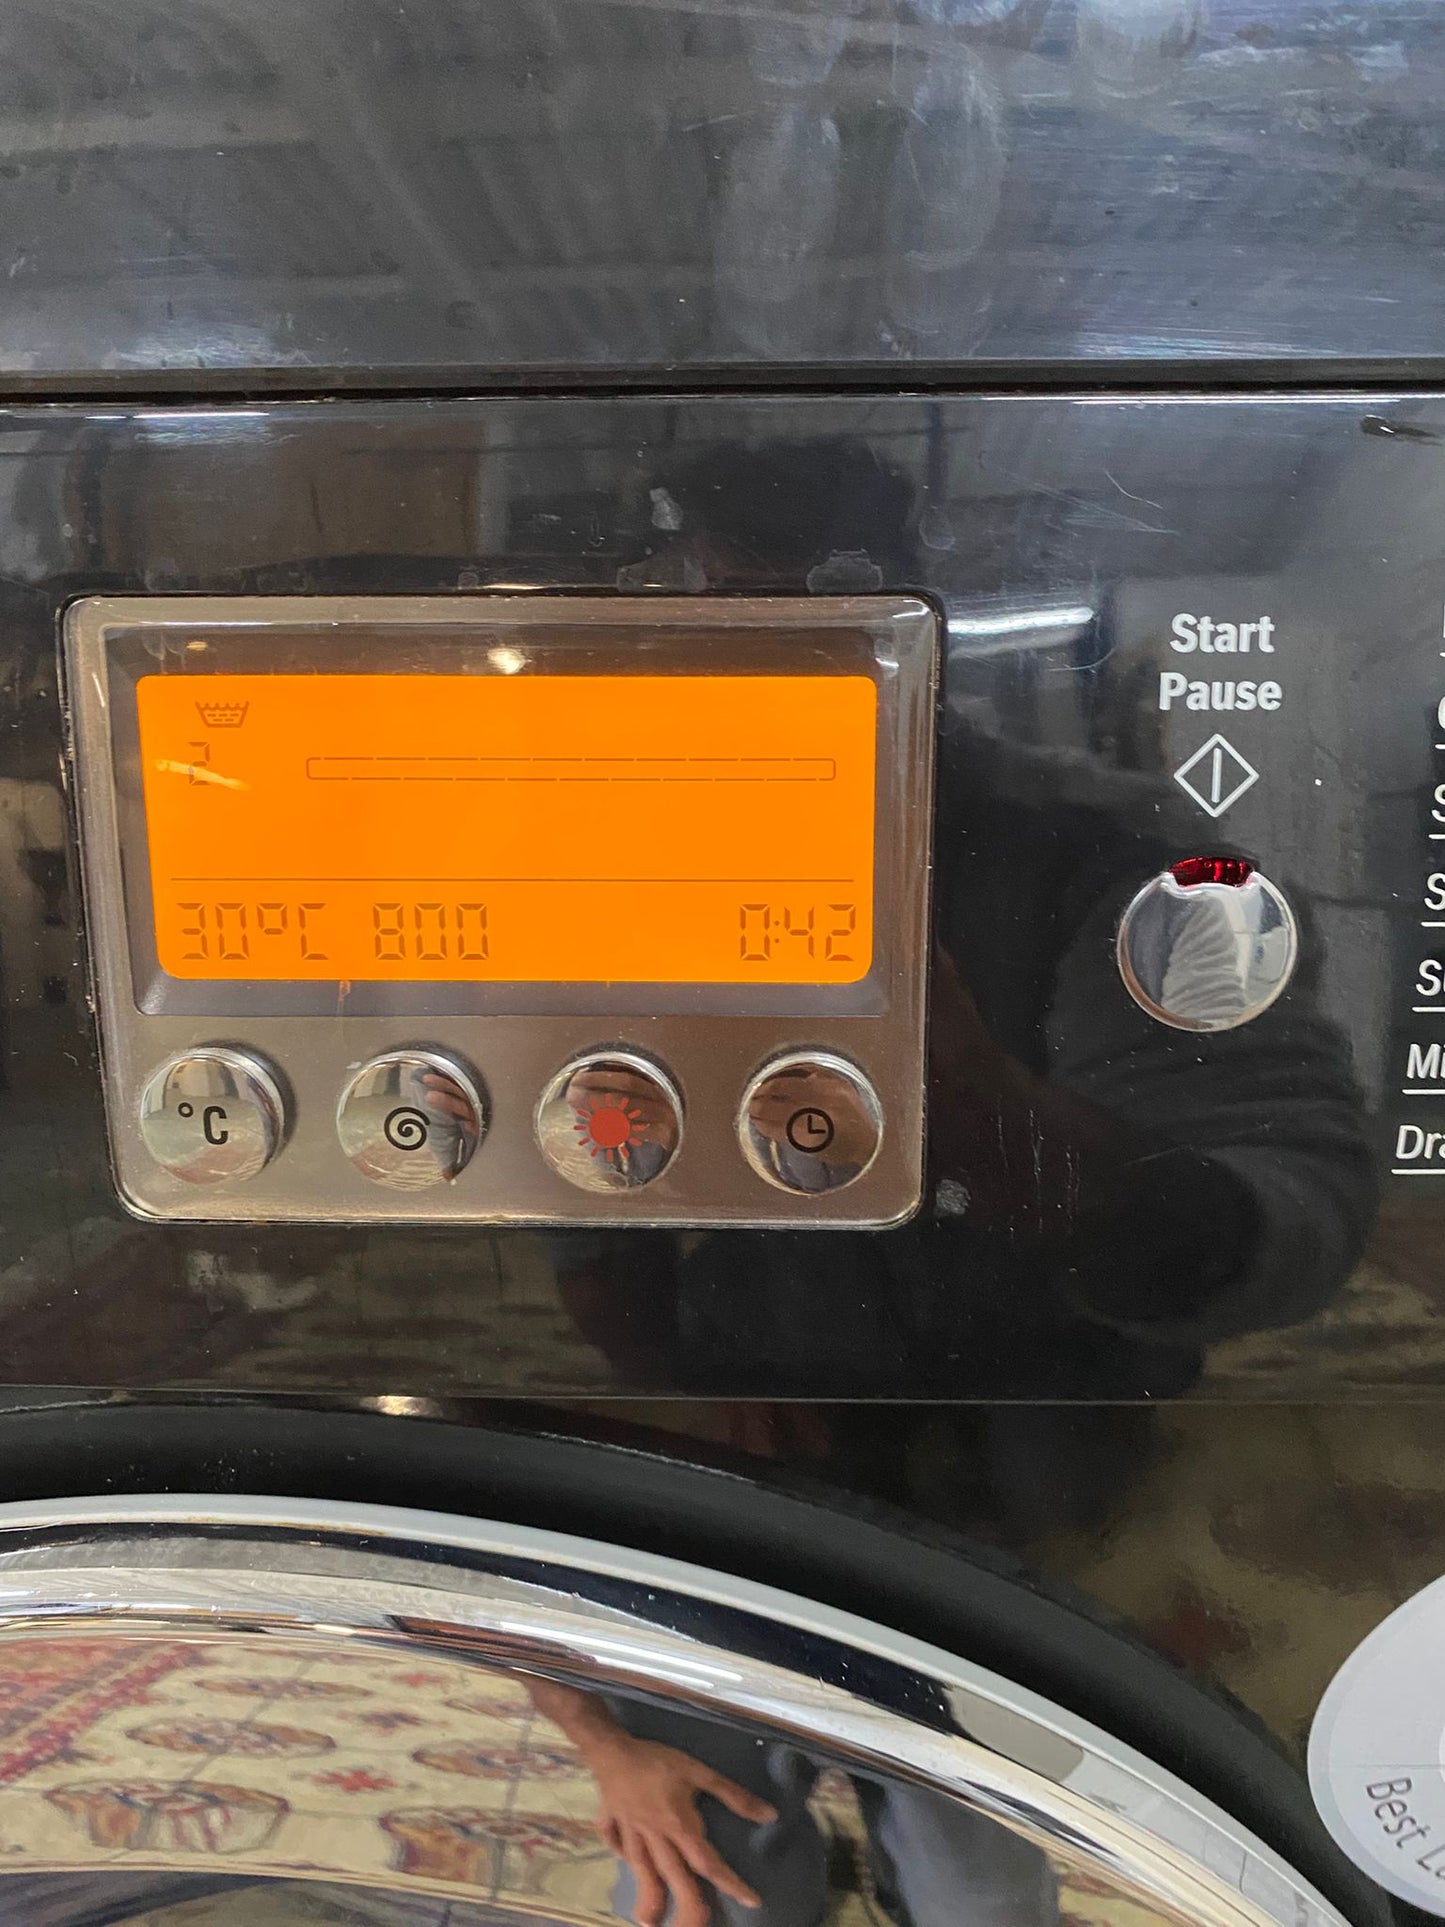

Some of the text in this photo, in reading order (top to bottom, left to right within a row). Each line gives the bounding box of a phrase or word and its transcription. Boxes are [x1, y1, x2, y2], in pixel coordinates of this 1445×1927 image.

[1169, 612, 1275, 653] Start
[1159, 671, 1283, 711] Pause
[372, 903, 489, 960] 800
[739, 904, 857, 962] 0:42
[1366, 1777, 1431, 1849] Best
